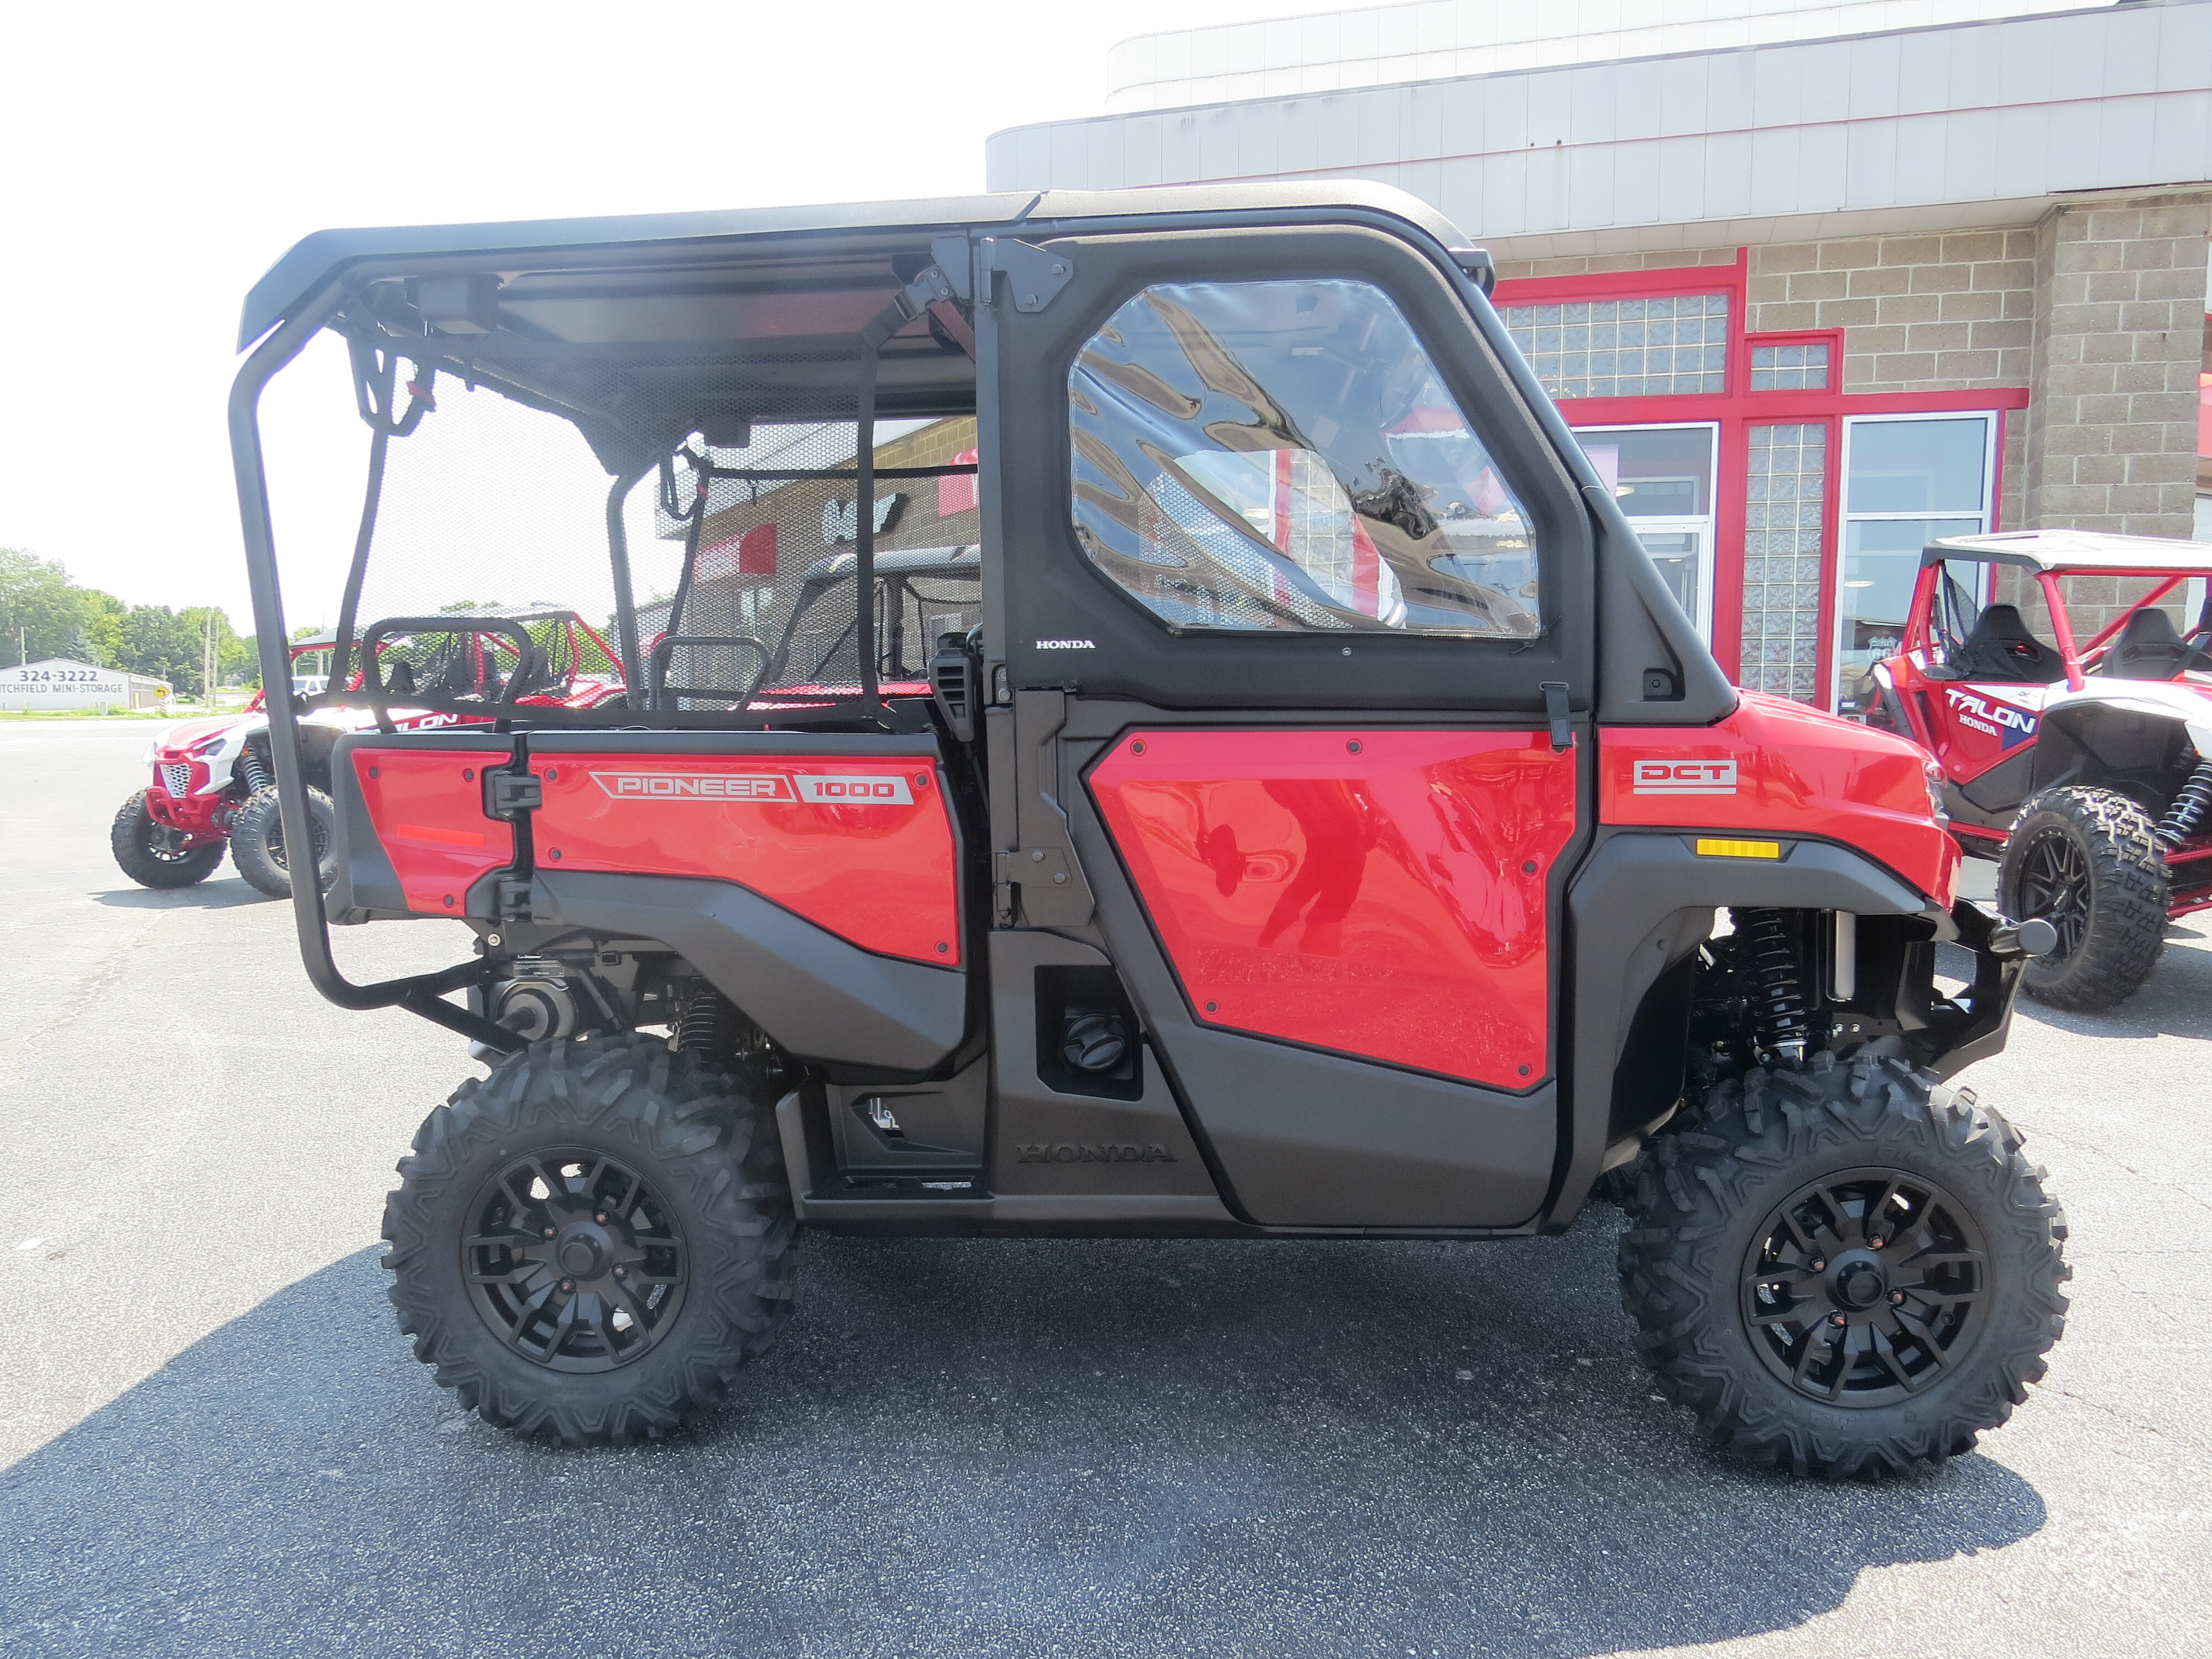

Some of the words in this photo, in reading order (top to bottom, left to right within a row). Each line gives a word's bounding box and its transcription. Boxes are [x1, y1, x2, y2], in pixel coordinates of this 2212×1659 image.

[1035, 639, 1096, 650] HONDA
[19, 670, 98, 682] 324-3222
[53, 684, 123, 693] MINI-STORAGE
[1945, 688, 2036, 734] TALON
[1959, 713, 1998, 737] HONDA
[1642, 765, 1730, 780] DCT
[618, 778, 776, 796] PIONEER
[813, 782, 895, 797] 1000
[1016, 1143, 1178, 1162] HONDA
